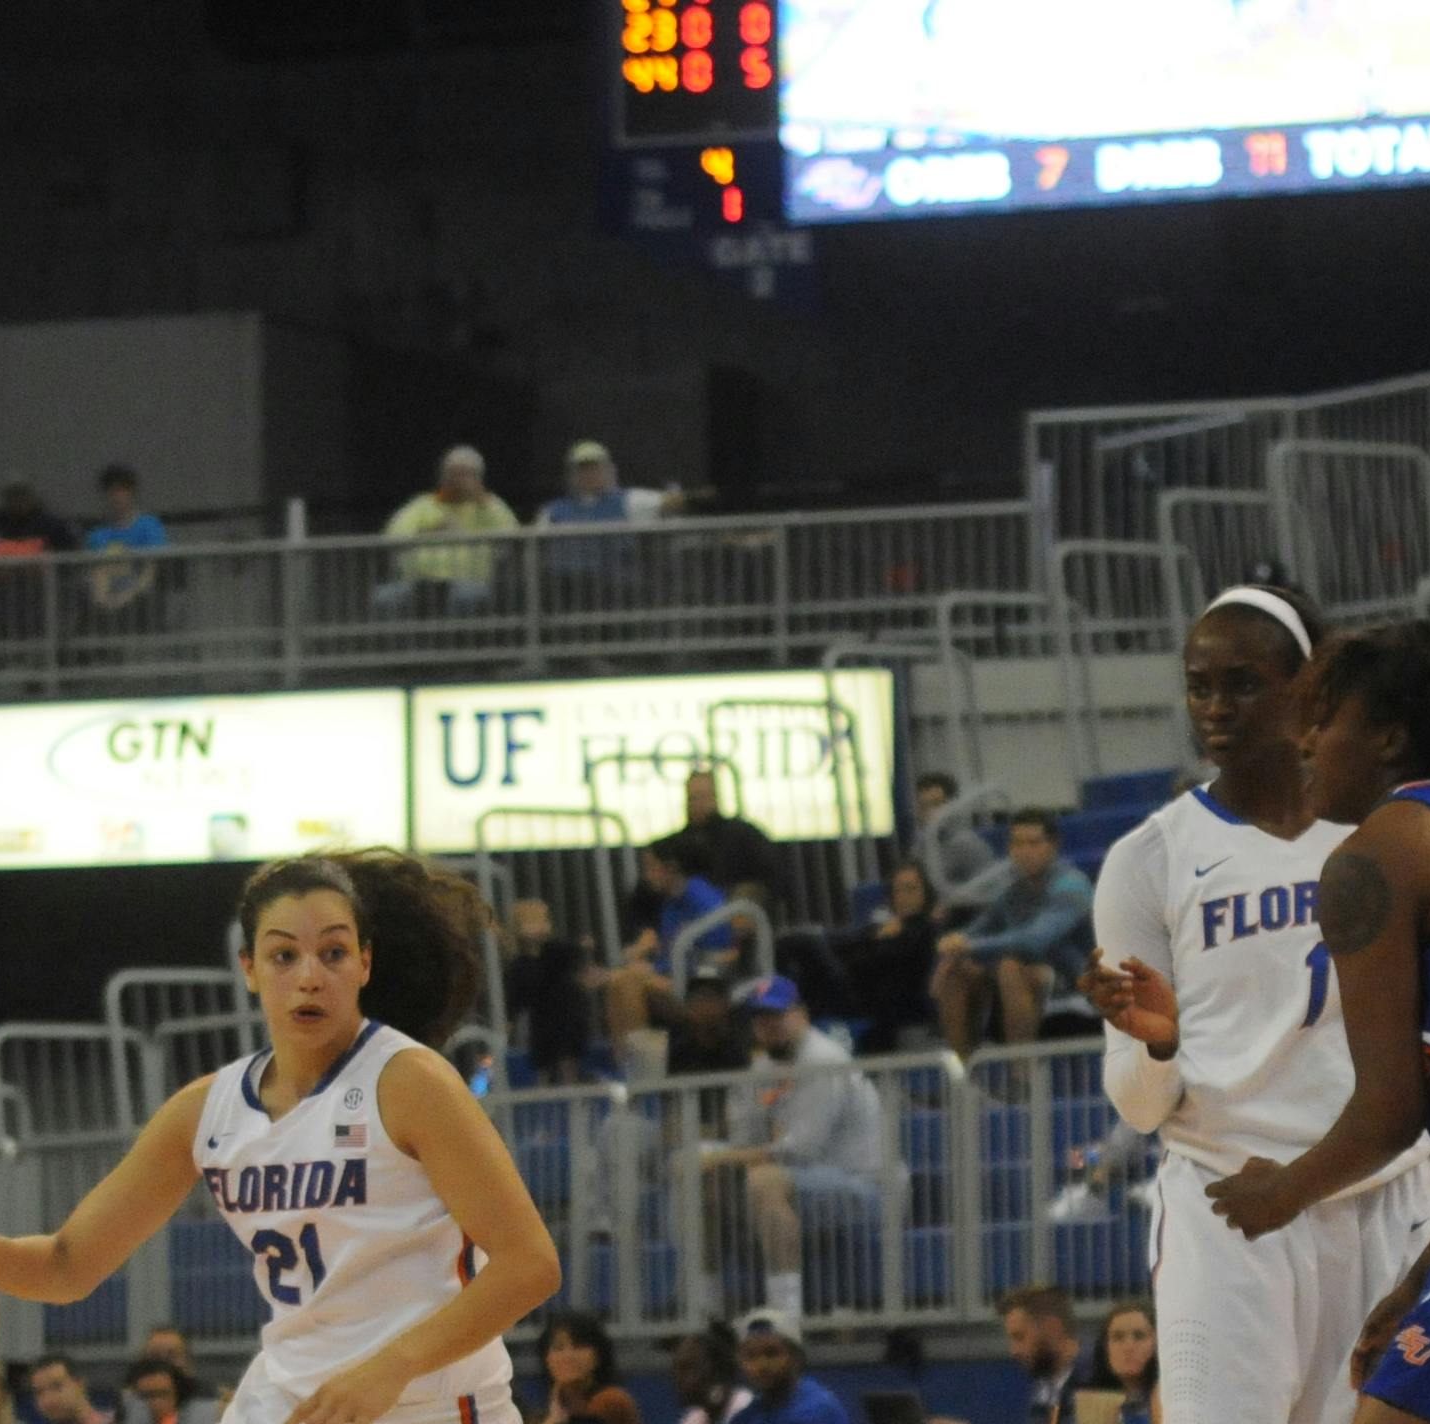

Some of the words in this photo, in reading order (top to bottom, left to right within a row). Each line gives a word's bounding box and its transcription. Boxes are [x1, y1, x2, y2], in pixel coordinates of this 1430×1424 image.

[1034, 146, 1069, 190] 7
[105, 716, 216, 764] GTN
[438, 708, 546, 787] UF
[1198, 880, 1323, 951] FLOR
[203, 1157, 368, 1214] FLORIDA
[250, 1222, 327, 1306] 21
